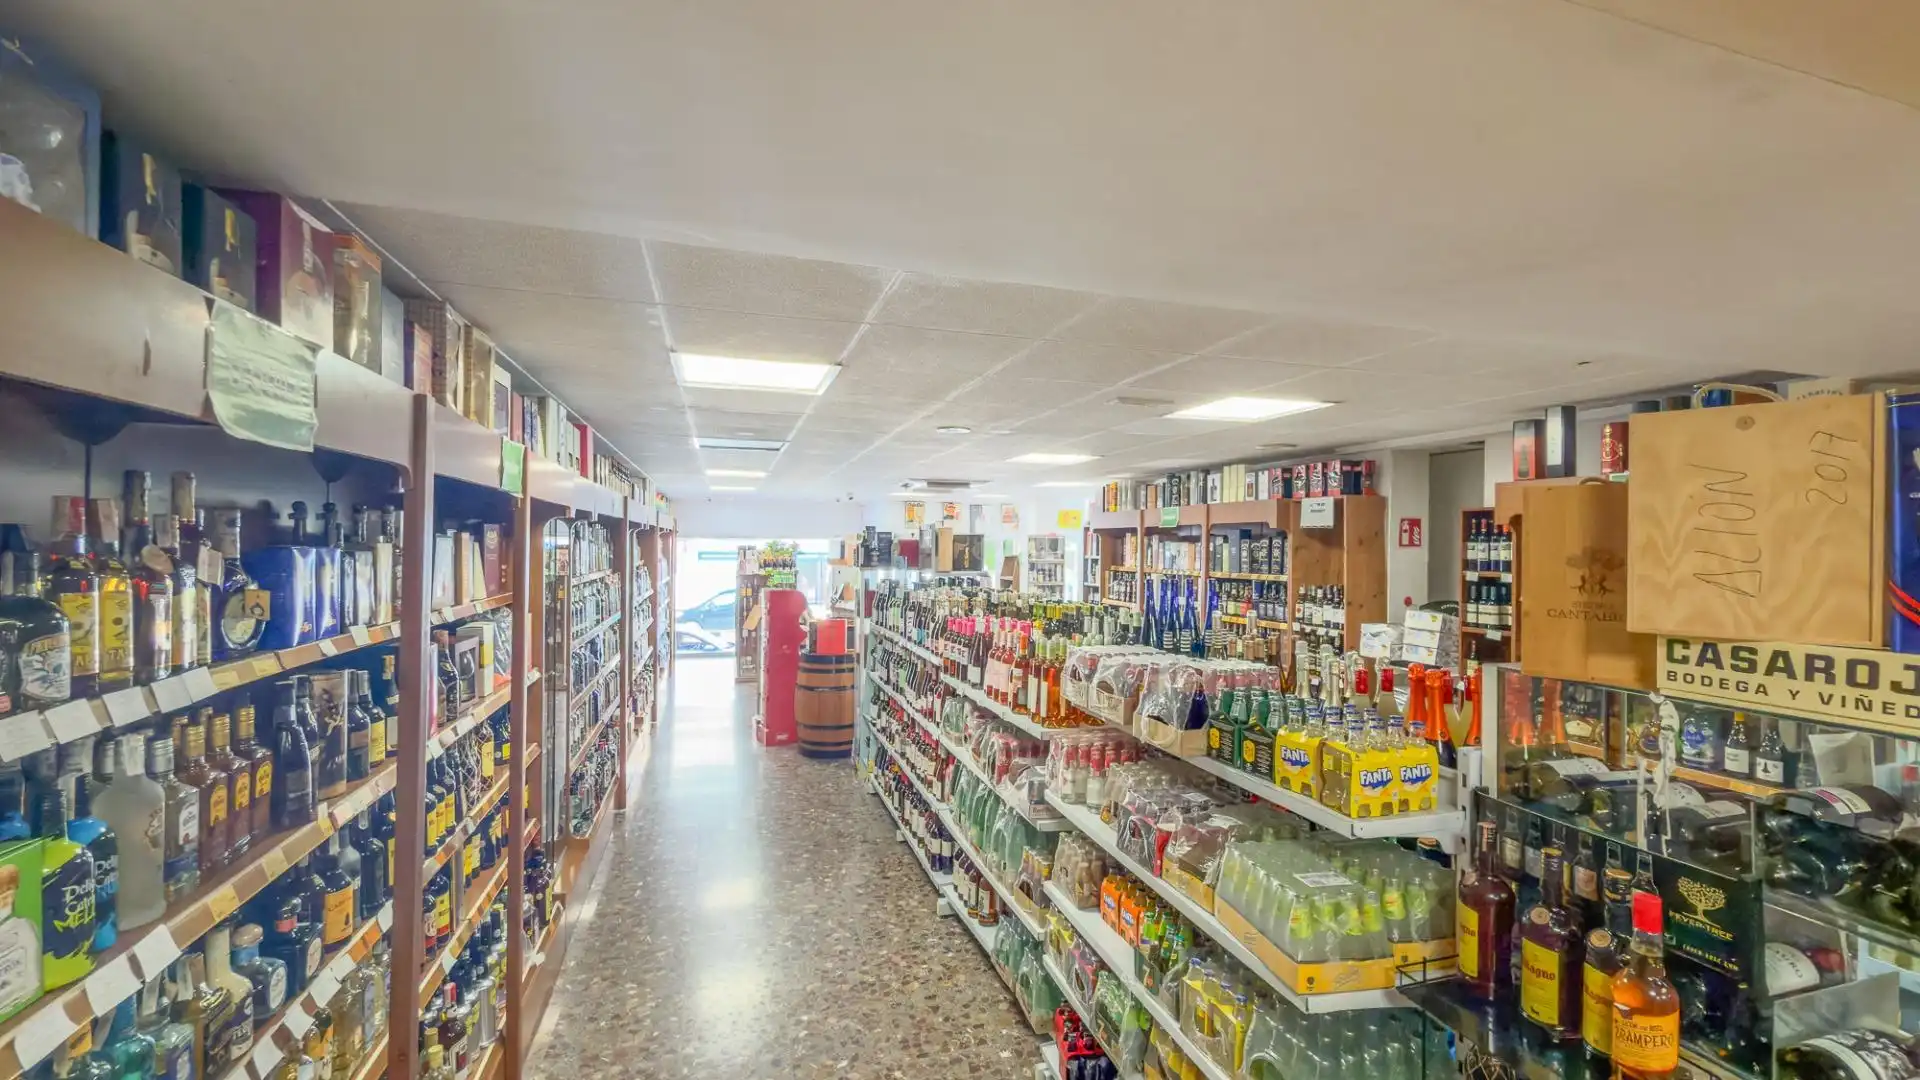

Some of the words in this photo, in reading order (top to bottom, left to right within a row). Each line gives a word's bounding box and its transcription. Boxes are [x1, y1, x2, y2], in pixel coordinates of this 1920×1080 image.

[1806, 431, 1857, 505] 2017
[1684, 463, 1763, 598] ALION
[1666, 670, 1769, 697] BODEGA
[1788, 689, 1801, 701] Y
[1280, 745, 1310, 763] FANTA
[1359, 767, 1393, 786] FANTA
[1400, 763, 1433, 782] FANTA
